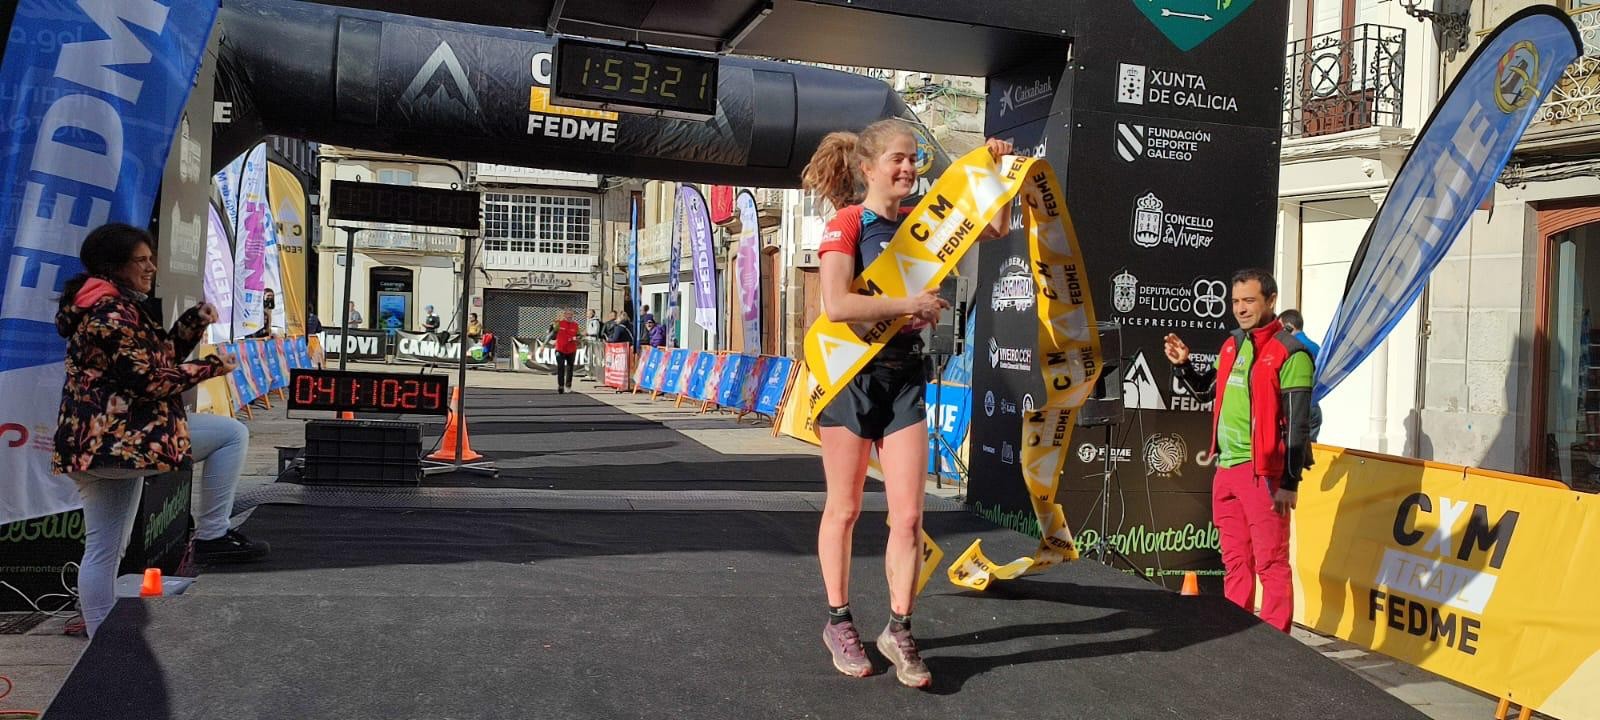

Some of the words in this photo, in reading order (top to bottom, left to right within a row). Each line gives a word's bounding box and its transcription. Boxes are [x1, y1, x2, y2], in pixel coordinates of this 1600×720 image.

[580, 57, 708, 100] 1:53:21
[1014, 77, 1052, 104] CaixaBank
[1151, 70, 1206, 90] XUNTA
[1150, 88, 1170, 104] DE
[1173, 91, 1238, 112] GALICIA
[527, 114, 618, 143] FEDME
[1147, 128, 1211, 142] FUNDACIÓN
[1147, 138, 1198, 151] DEPORTE
[1147, 149, 1192, 161] GALEGO
[1007, 157, 1027, 181] FED
[1034, 171, 1059, 218] FEDME
[910, 193, 954, 243] CXM
[1164, 213, 1214, 228] CONCELLO
[936, 217, 976, 263] FEDME
[1162, 235, 1174, 244] de
[1064, 264, 1084, 305] FEDME
[1139, 286, 1191, 297] DEPUTACIÓN
[1139, 297, 1150, 305] DE
[1151, 298, 1191, 312] LUGO
[863, 315, 899, 347] FEDM
[1113, 316, 1226, 330] VICEPRESIDENCIA
[326, 334, 379, 355] MOVI
[400, 338, 461, 358] CAMOVI
[1081, 346, 1097, 383] FEDME
[295, 374, 441, 409] 0:41:10:24
[1170, 396, 1214, 413] FEDM
[1053, 409, 1072, 447] FEDME
[1098, 447, 1132, 457] FDME
[1393, 492, 1520, 570] CXM
[1396, 557, 1469, 604] TRAIL
[1368, 587, 1482, 656] FEDME
